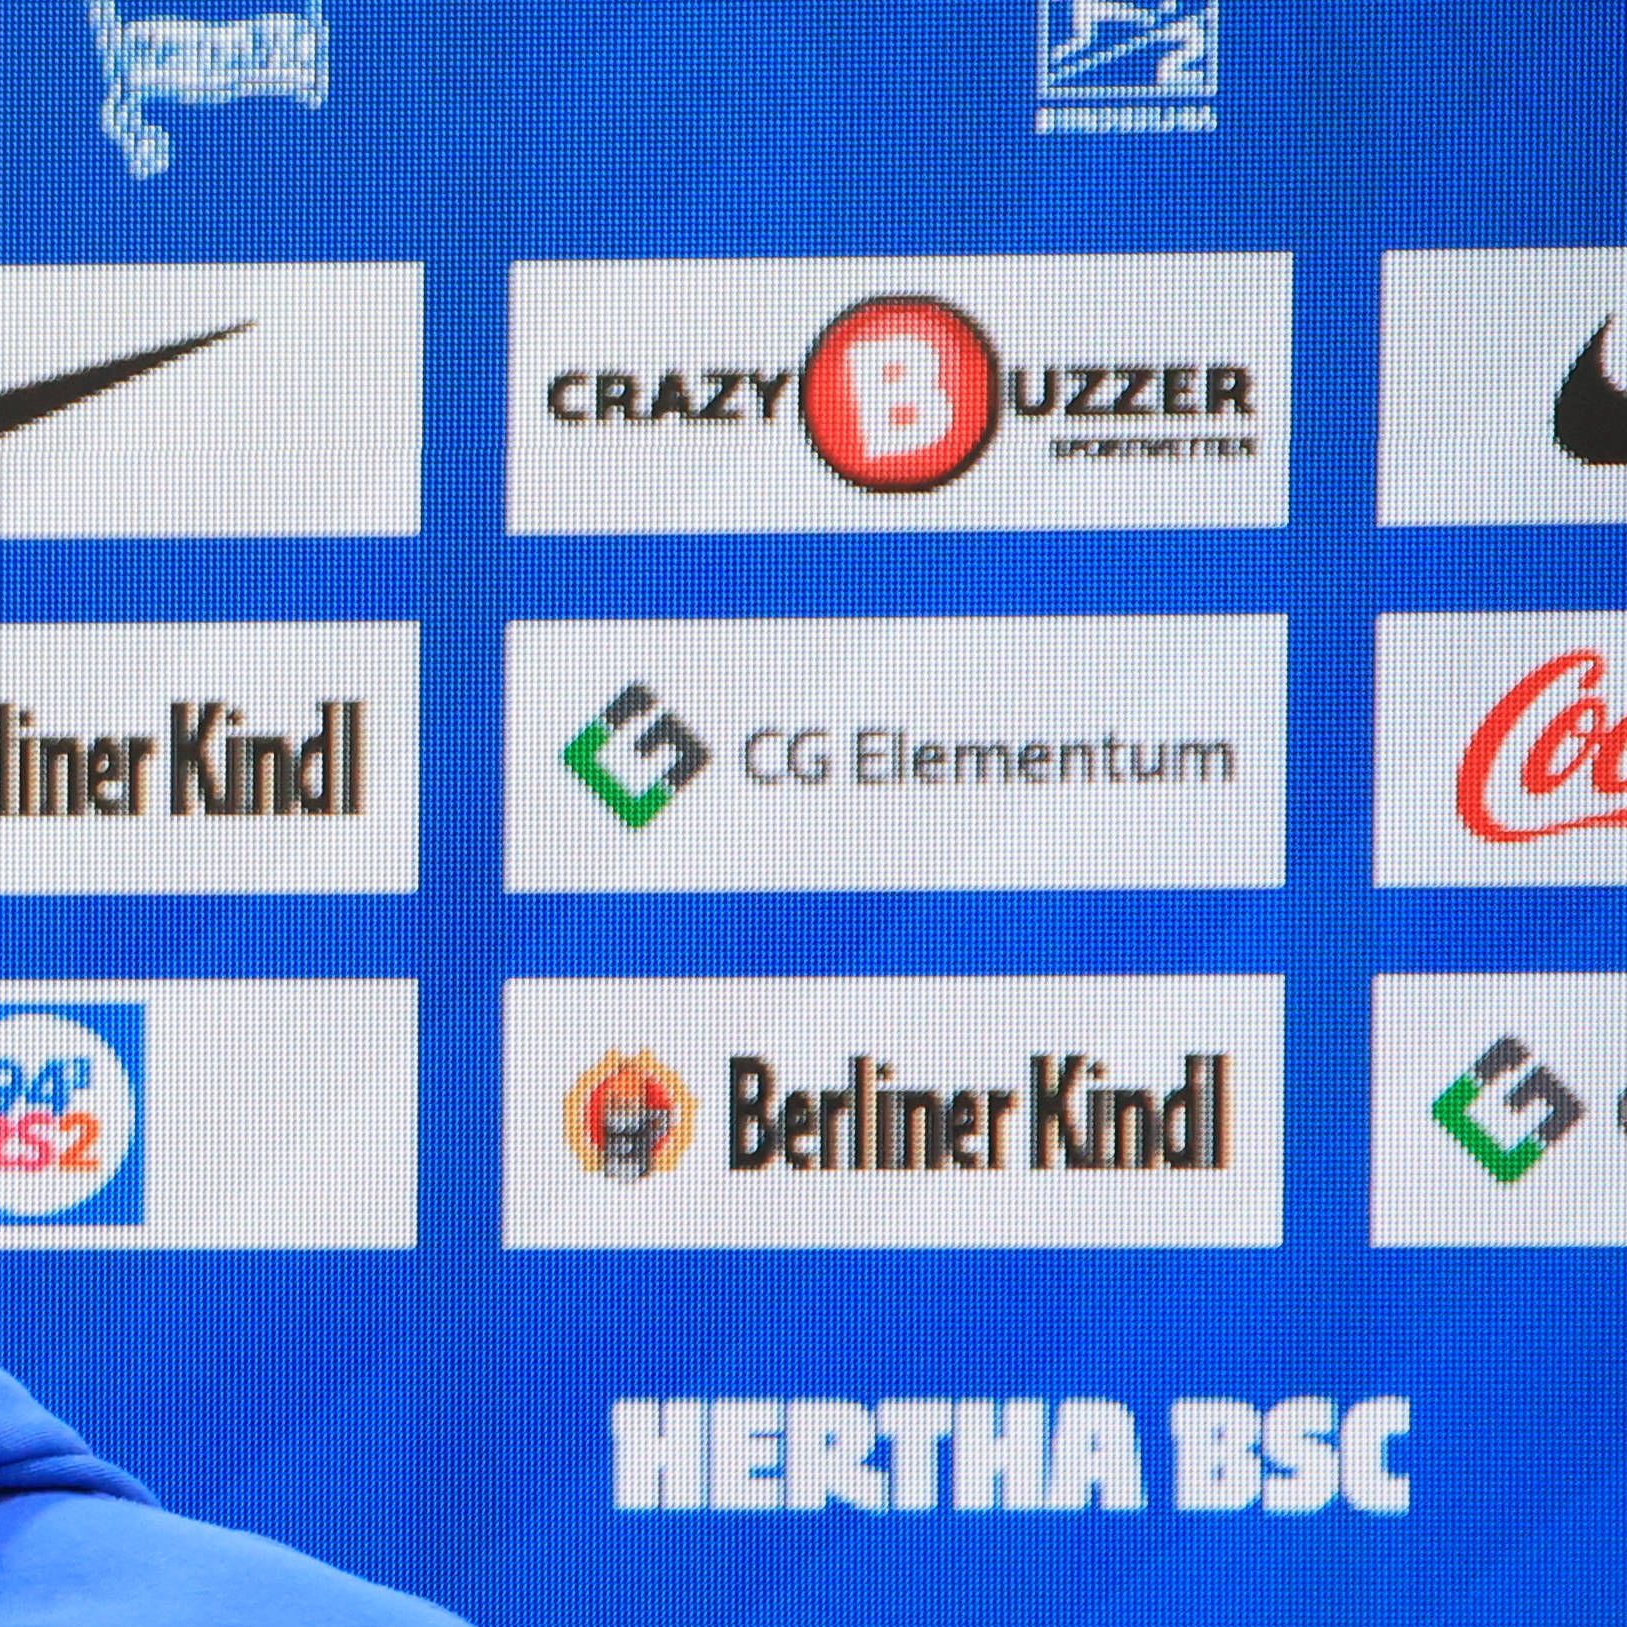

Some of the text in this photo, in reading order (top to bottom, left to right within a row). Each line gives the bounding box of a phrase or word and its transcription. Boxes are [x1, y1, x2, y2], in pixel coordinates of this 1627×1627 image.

[547, 368, 790, 423] CRAZY
[168, 702, 366, 816] Kindl
[743, 731, 1237, 784] CG Elementum
[729, 1054, 1231, 1170] Berliner Kindl
[613, 1396, 1411, 1514] HERTHA BSC
